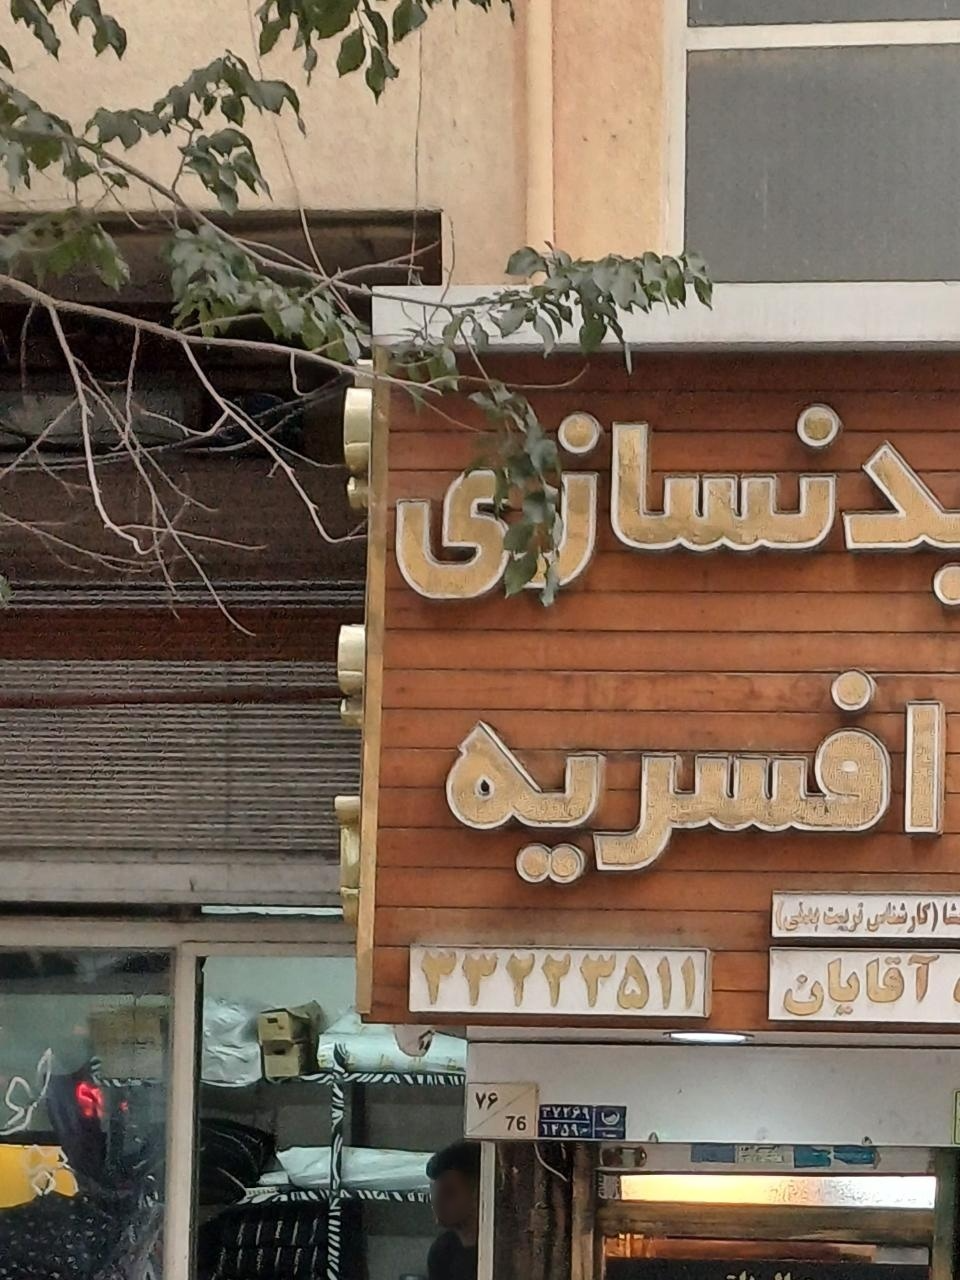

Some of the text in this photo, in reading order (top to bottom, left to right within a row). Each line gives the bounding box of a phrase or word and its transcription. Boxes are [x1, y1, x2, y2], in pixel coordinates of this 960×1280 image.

[447, 669, 943, 883] افسریه
[421, 952, 696, 1010] ۳۳۲۲۳۵۱۱
[783, 953, 940, 1016] آقایان
[474, 1091, 498, 1110] ۷۶
[505, 1115, 526, 1131] 76
